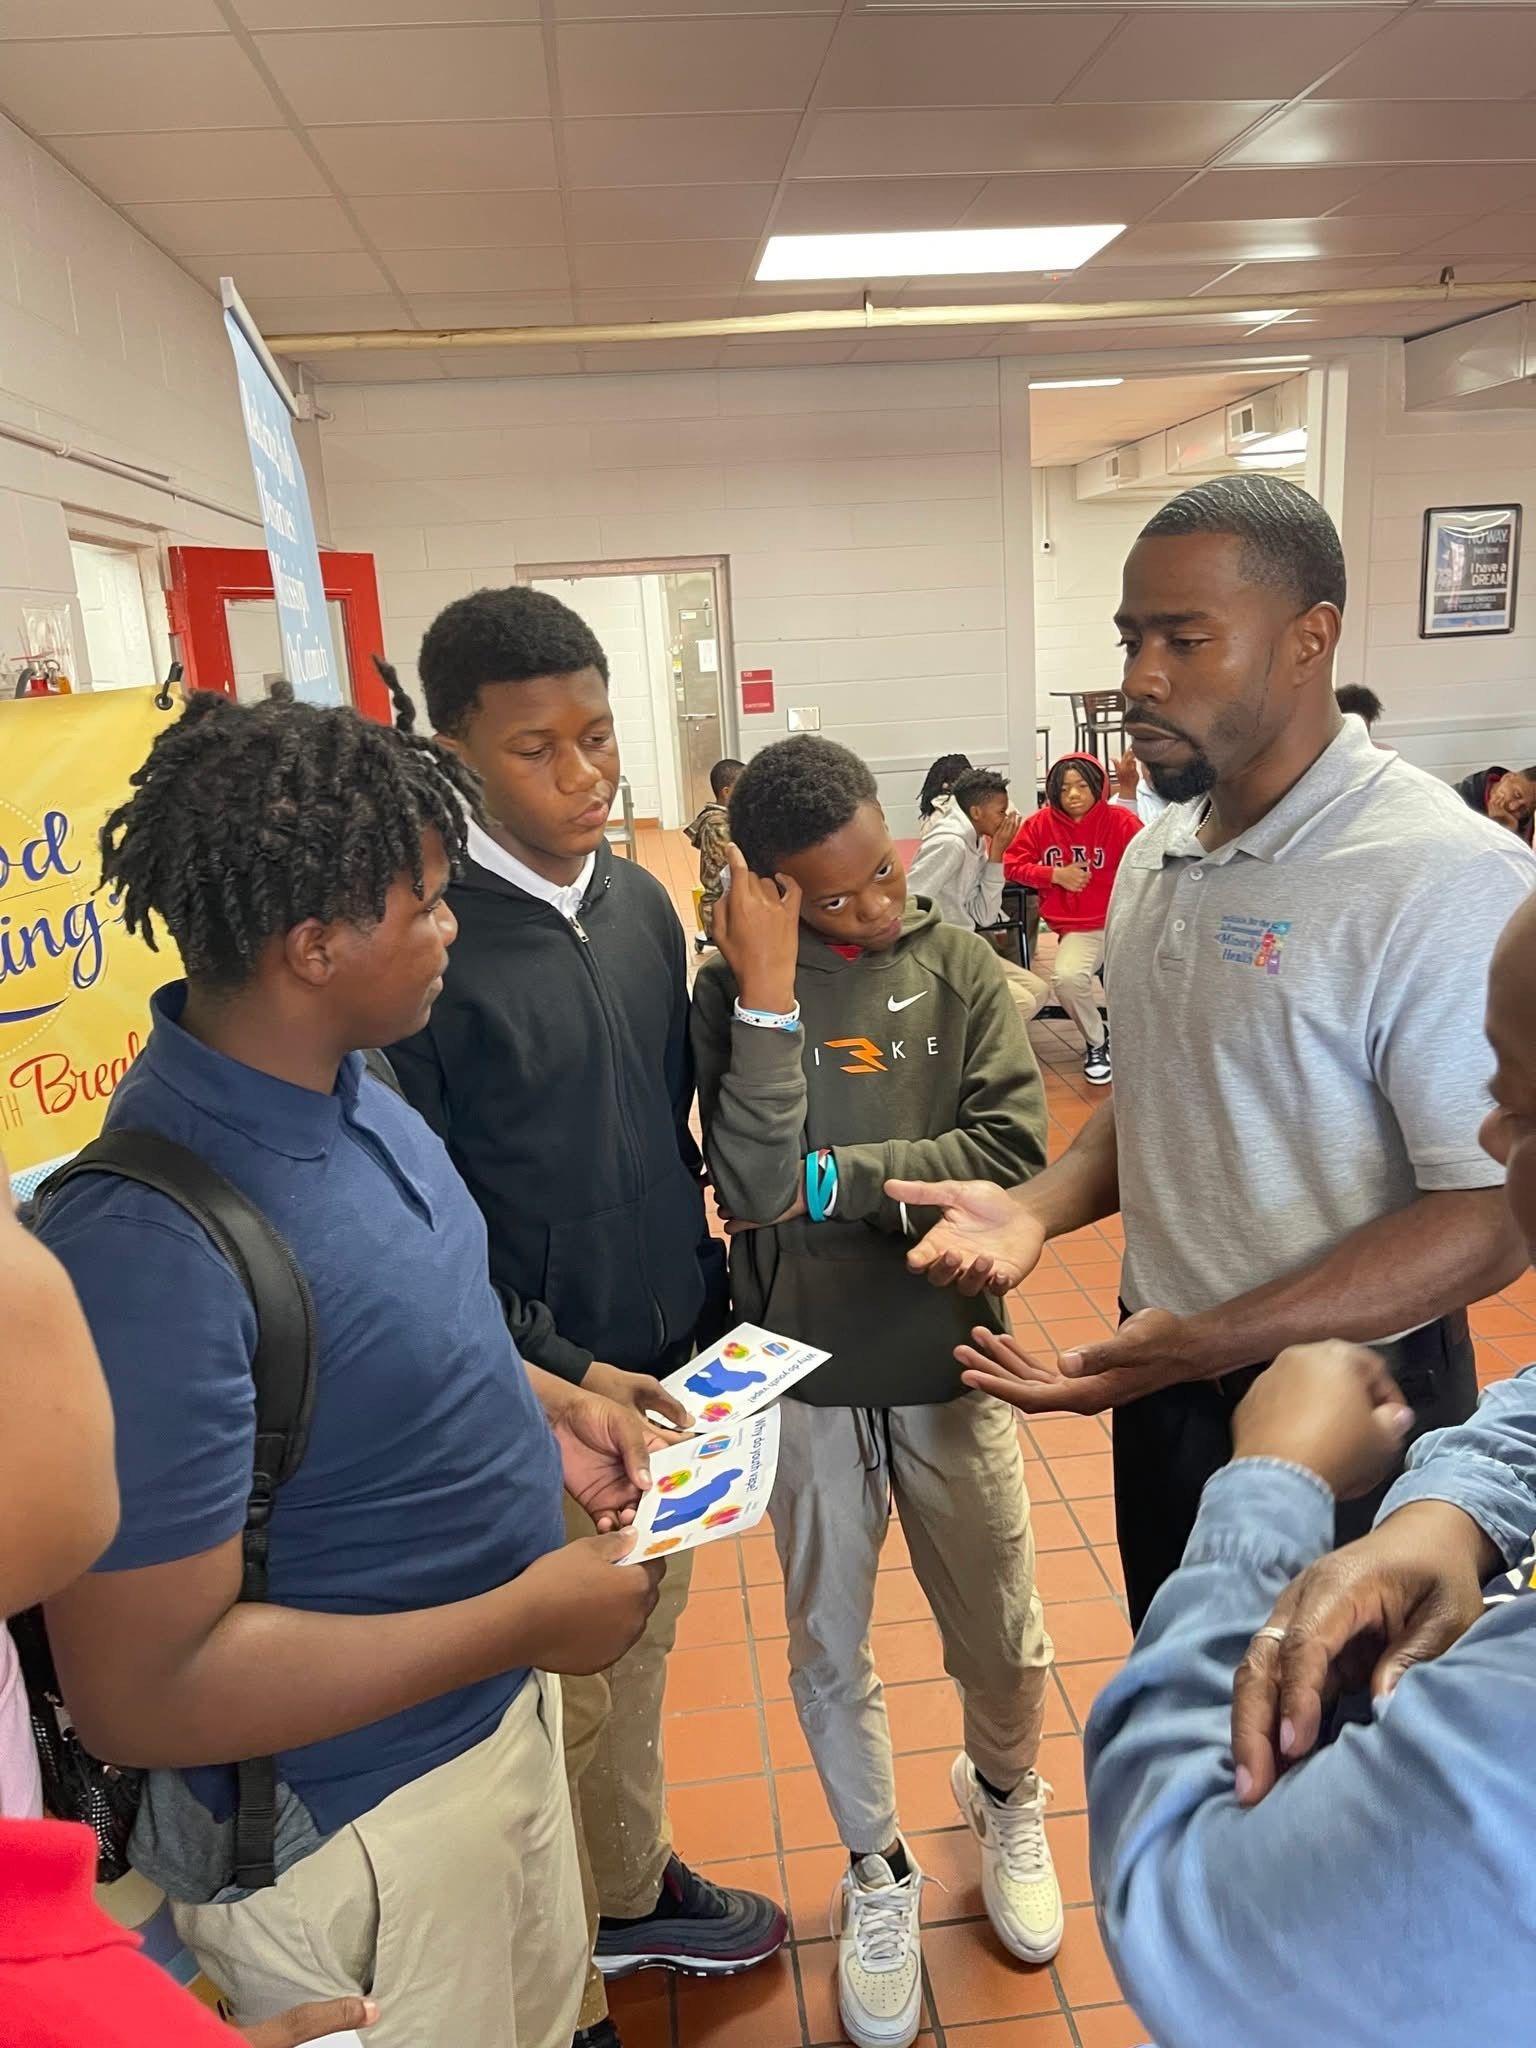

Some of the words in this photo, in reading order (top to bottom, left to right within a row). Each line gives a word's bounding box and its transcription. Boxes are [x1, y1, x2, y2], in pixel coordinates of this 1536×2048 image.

[1475, 562, 1498, 574] have
[0, 811, 81, 889] d
[0, 892, 118, 989] ing
